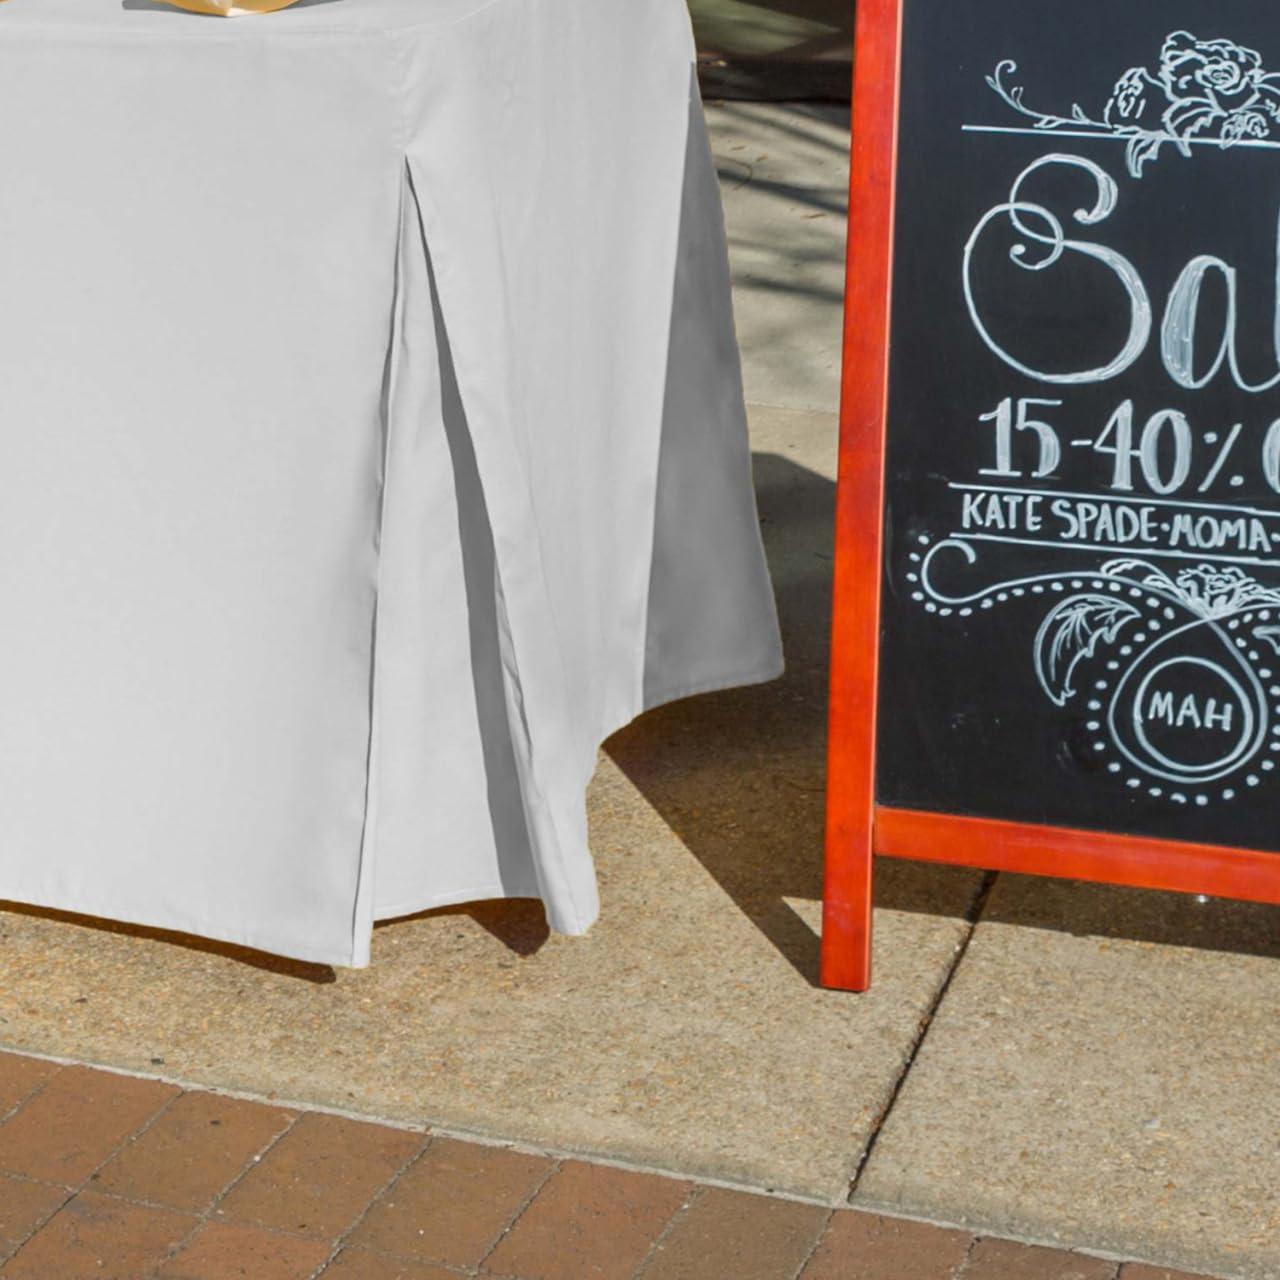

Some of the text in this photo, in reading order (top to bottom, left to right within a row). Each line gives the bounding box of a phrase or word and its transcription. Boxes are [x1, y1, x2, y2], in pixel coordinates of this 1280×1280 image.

[963, 153, 1280, 393] Sa
[978, 397, 1244, 496] 15-40%
[961, 492, 1043, 531] KATE
[1148, 691, 1233, 732] MAH
